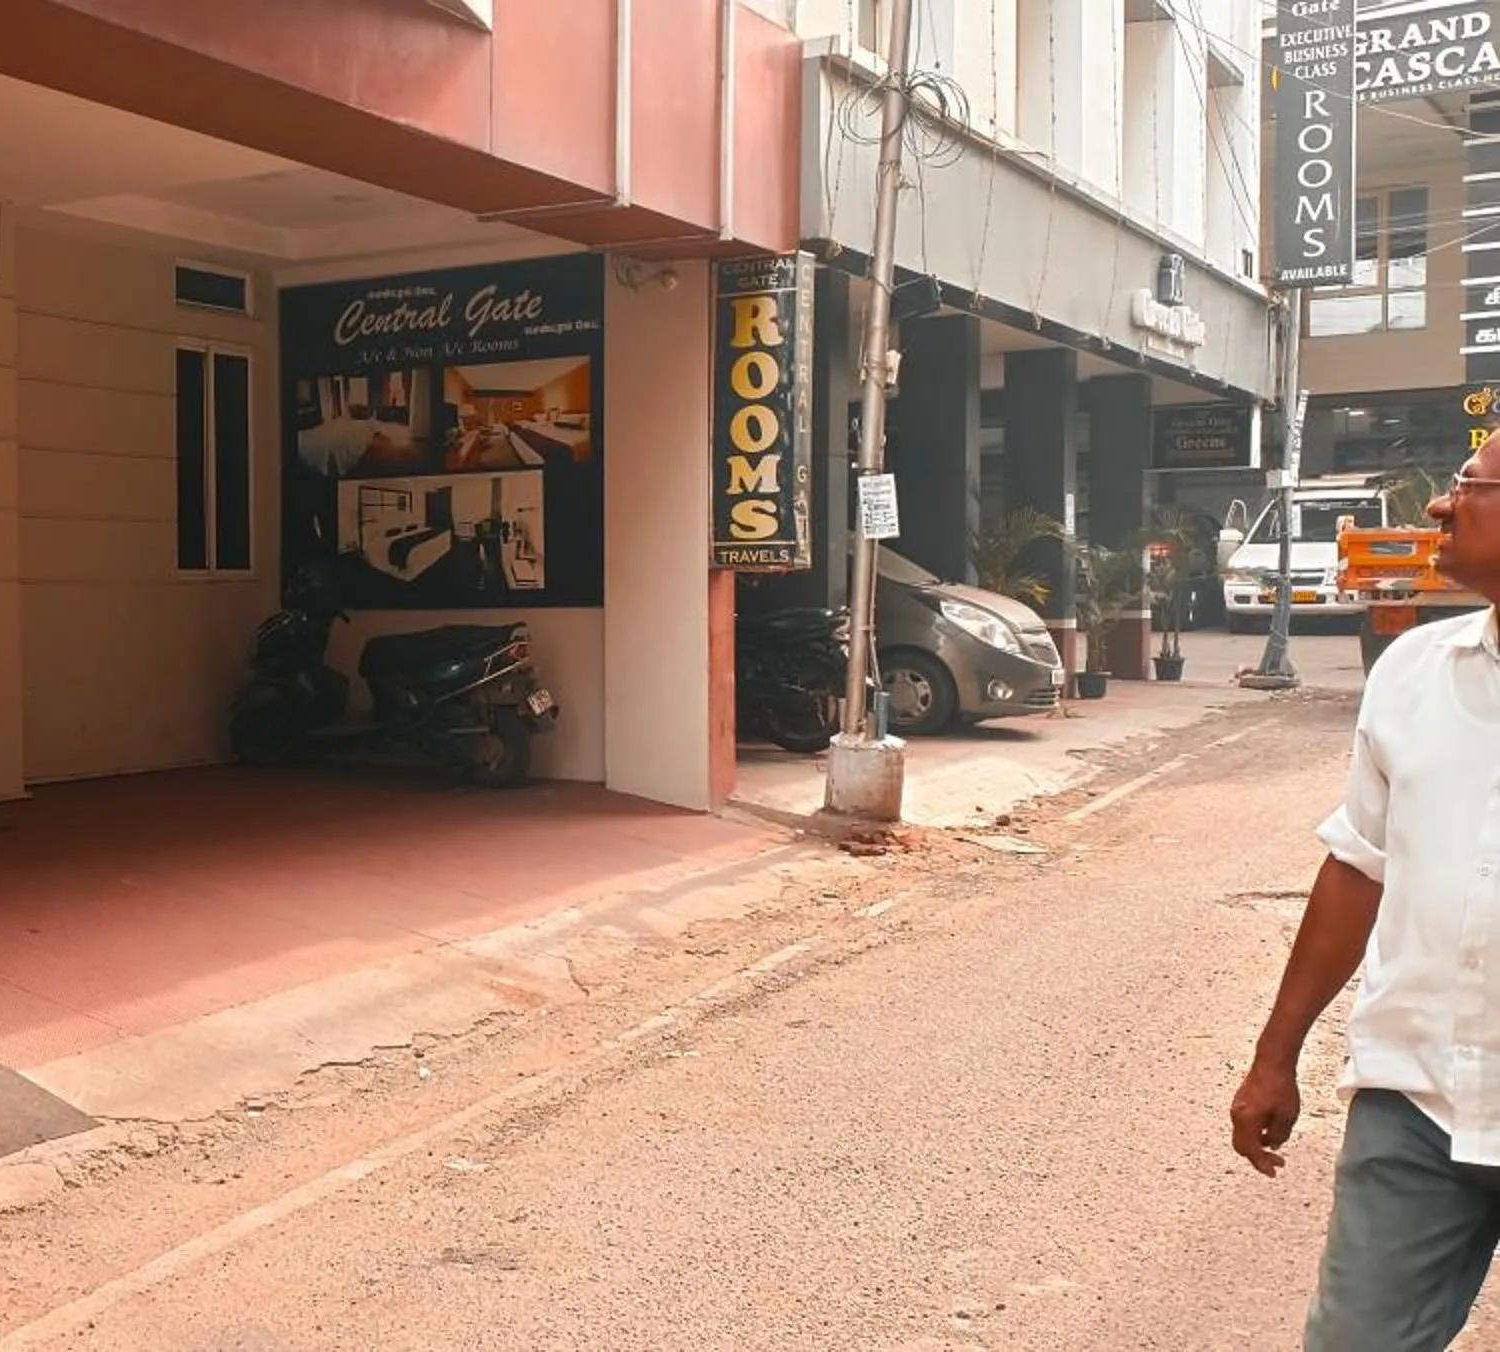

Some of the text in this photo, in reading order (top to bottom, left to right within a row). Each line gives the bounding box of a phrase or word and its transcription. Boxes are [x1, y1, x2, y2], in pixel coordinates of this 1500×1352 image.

[1292, 0, 1340, 16] Gate
[1280, 24, 1352, 47] EXECUTIVE
[1284, 42, 1348, 64] BUSINESS
[1295, 61, 1337, 79] CLASS
[1294, 90, 1334, 257] ROOMS
[1281, 264, 1348, 281] AVAILABLE
[334, 284, 542, 345] Central Gate
[726, 295, 784, 539] ROOMS
[717, 549, 789, 563] TRAVELS
